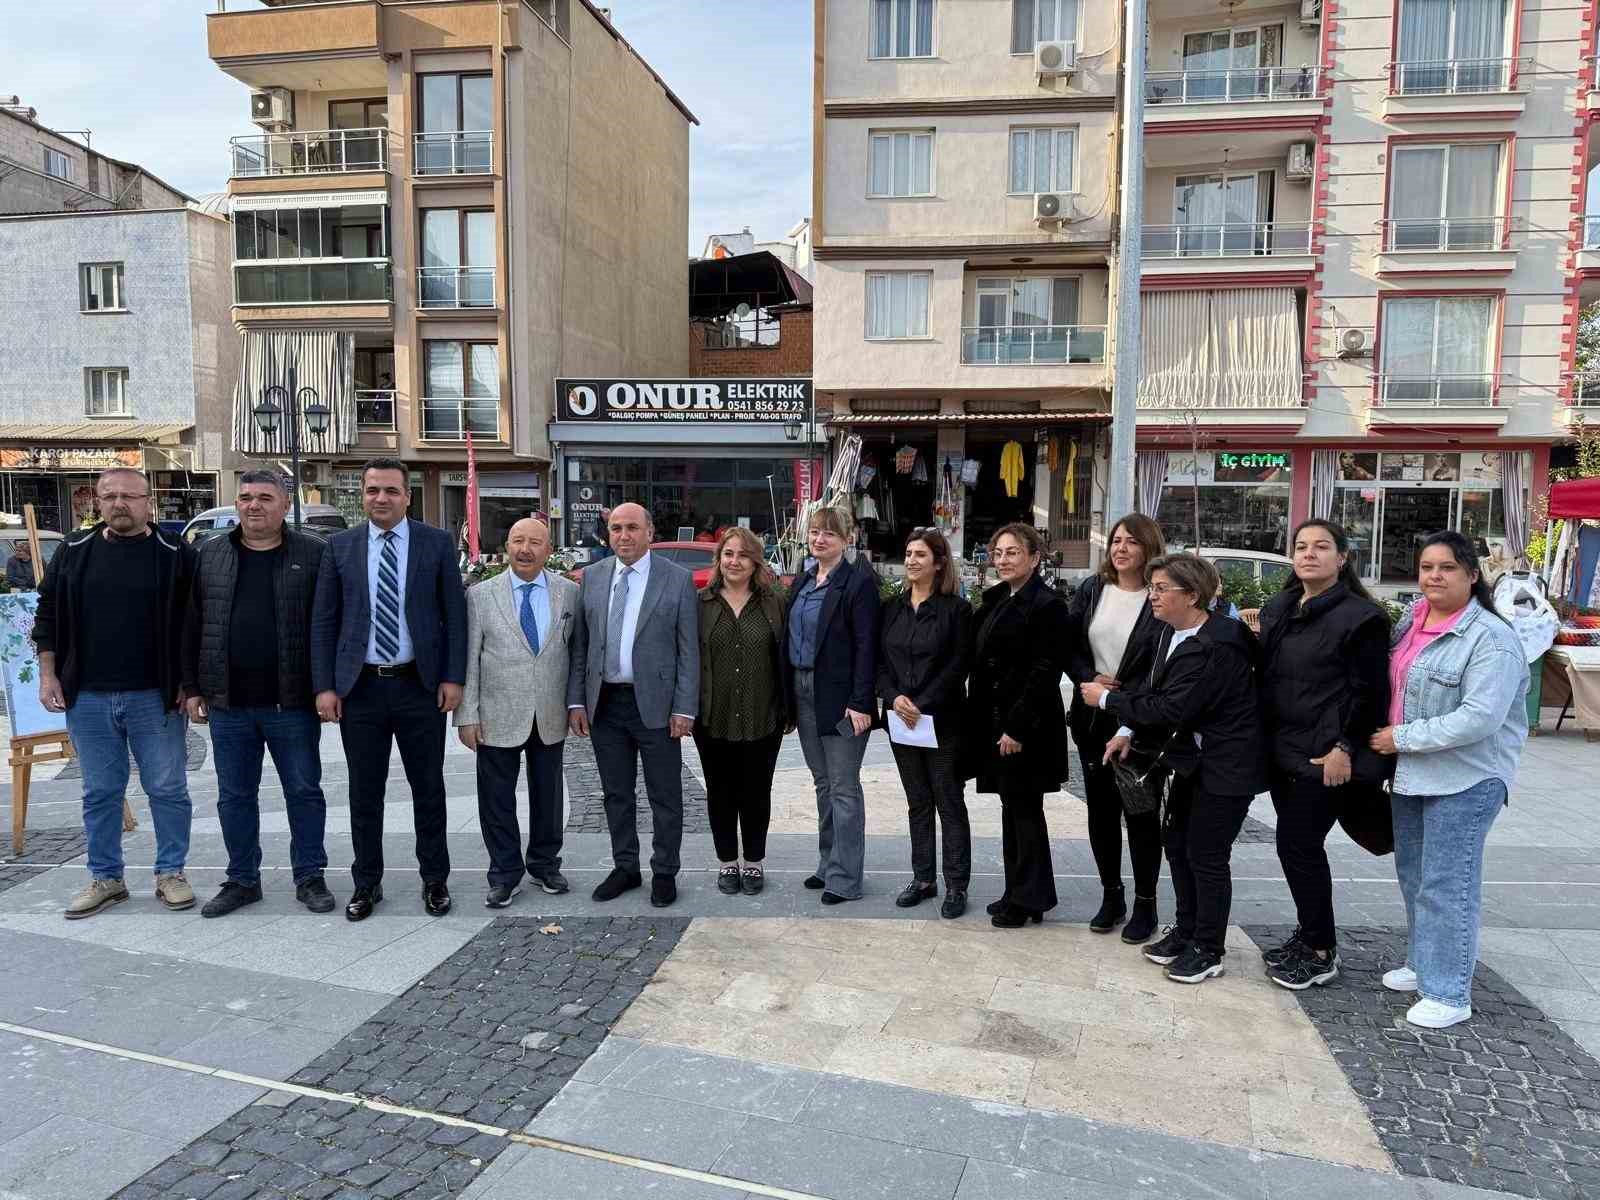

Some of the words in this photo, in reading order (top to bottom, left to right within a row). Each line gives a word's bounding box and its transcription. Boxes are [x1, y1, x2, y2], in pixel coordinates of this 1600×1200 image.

[606, 382, 724, 409] ONUR
[727, 383, 805, 398] ELEKTRİK
[727, 401, 751, 410] 0541
[755, 401, 774, 410] 856
[776, 401, 789, 410] 29
[734, 412, 755, 420] PROJE
[780, 412, 802, 420] TRAFO
[1221, 453, 1239, 469] İÇ
[1241, 453, 1286, 468] GİYİM
[571, 503, 603, 512] ONUR
